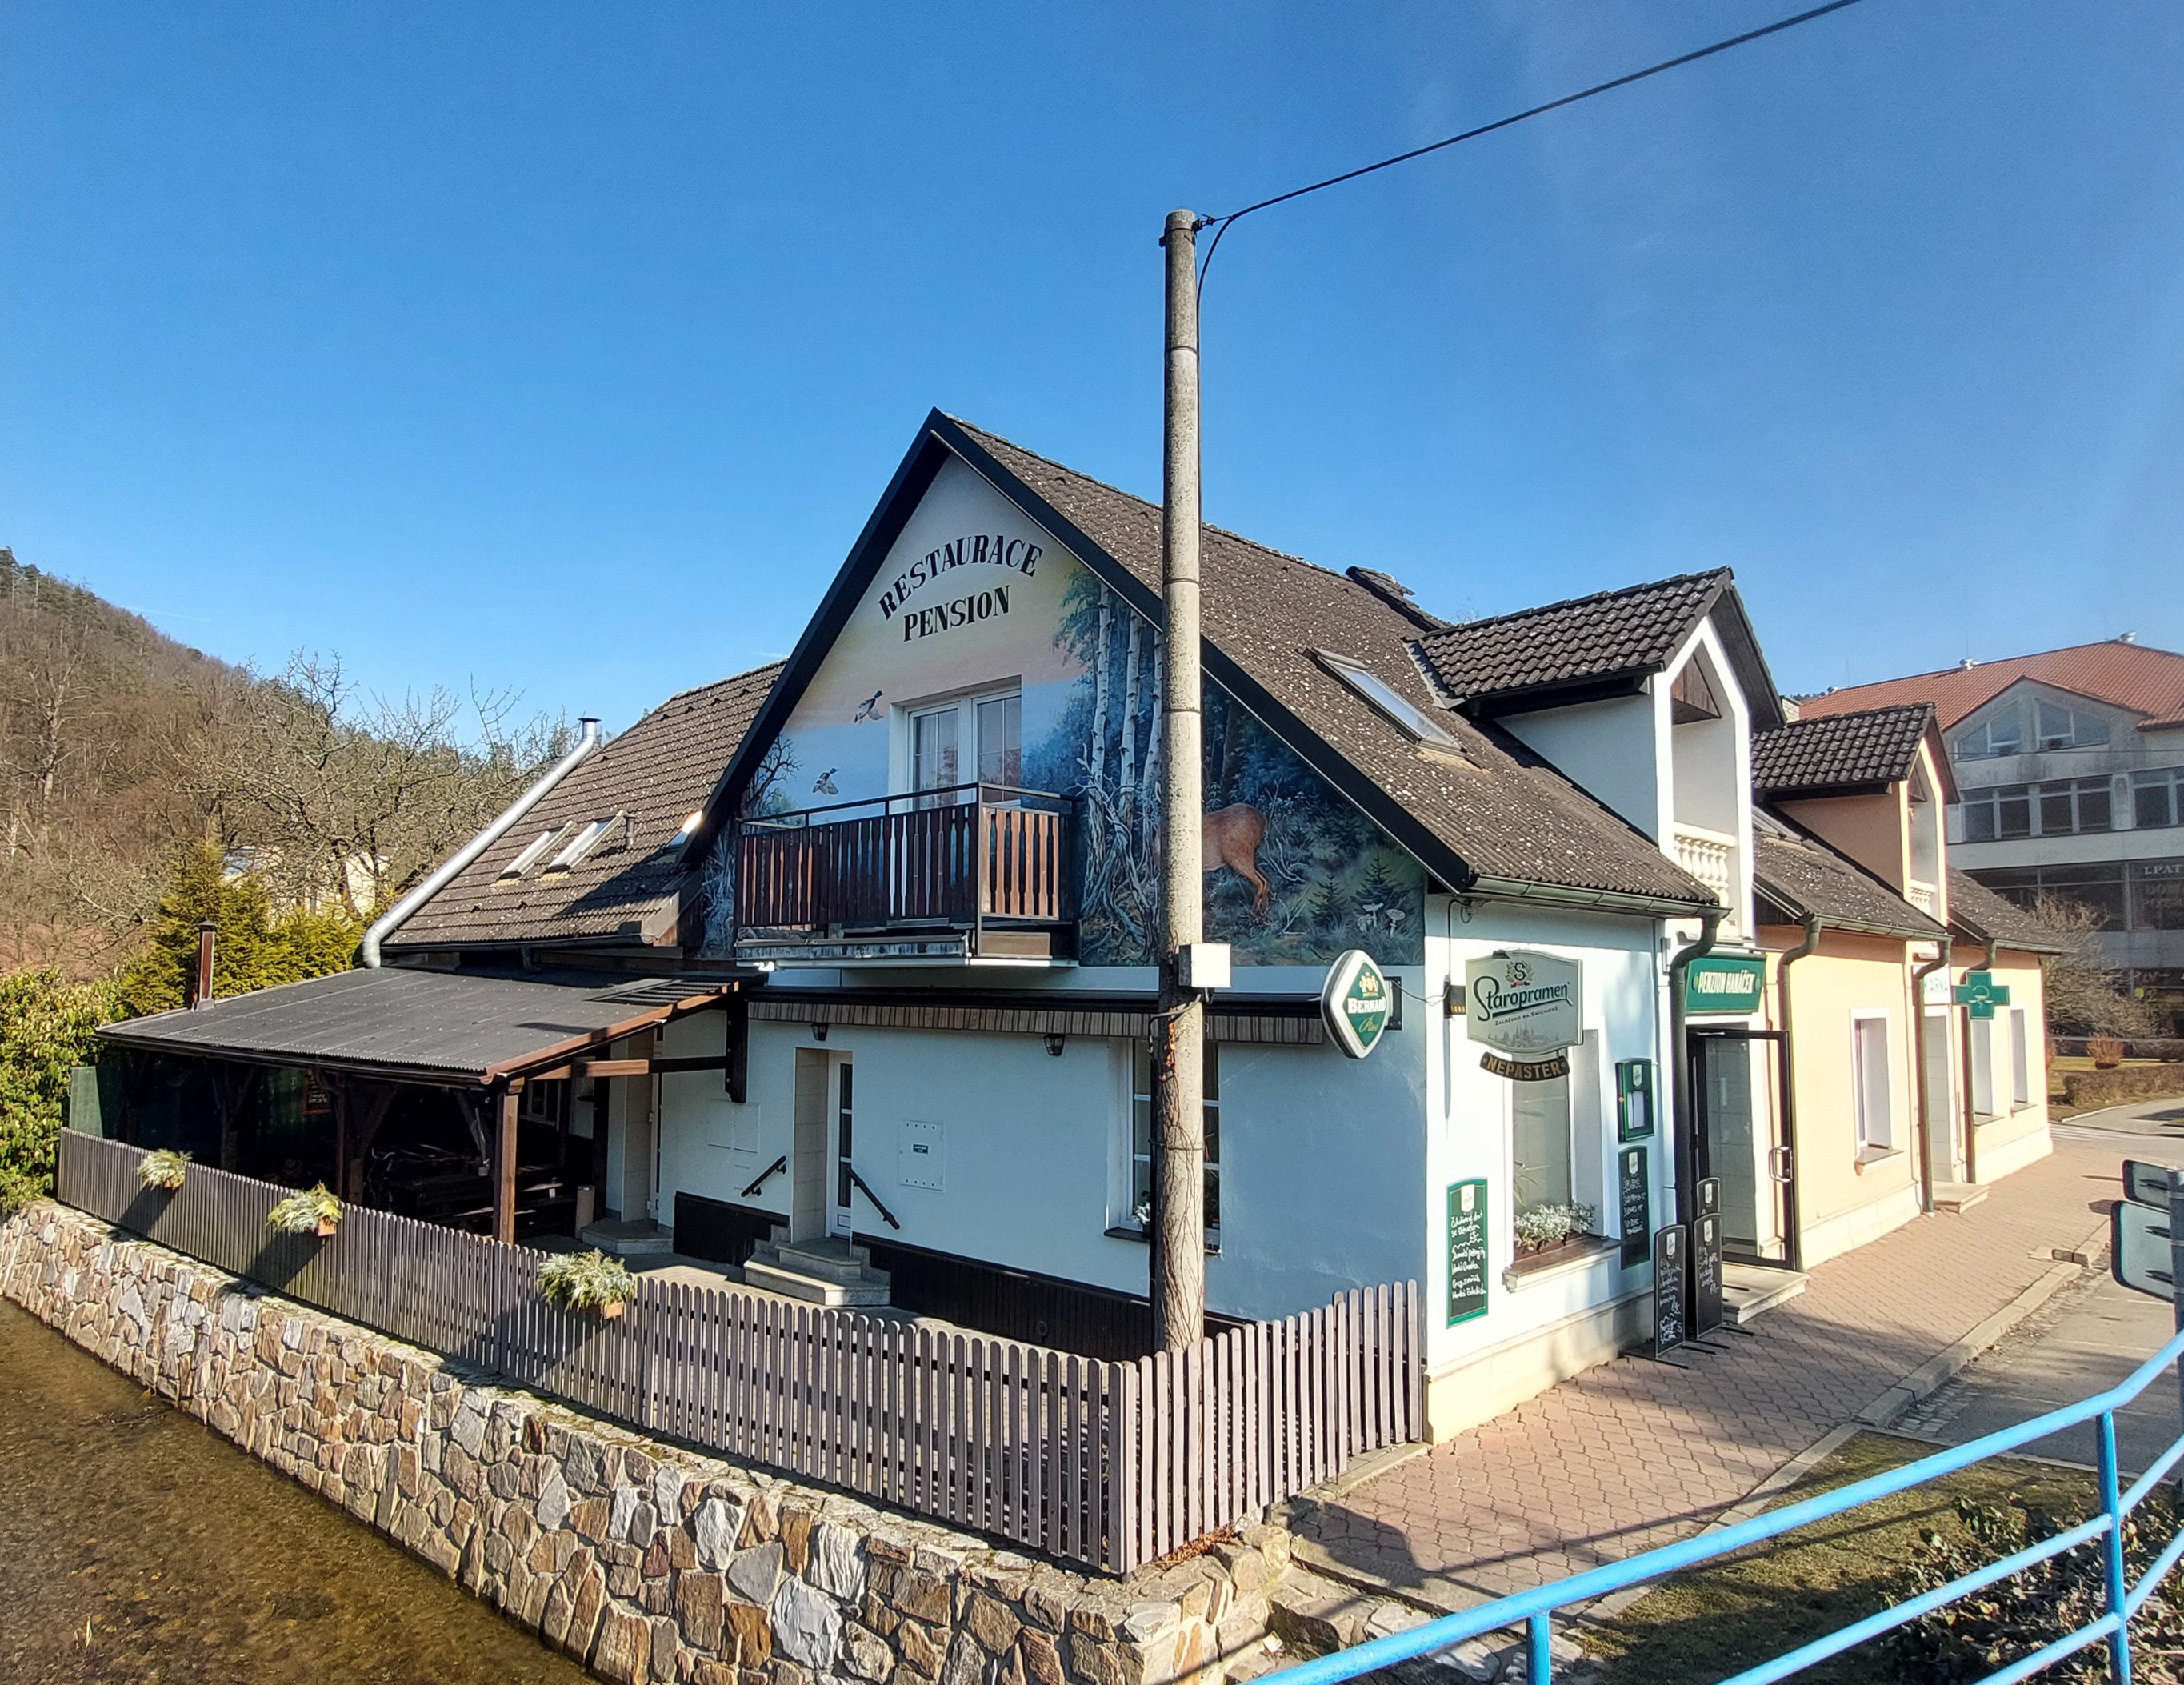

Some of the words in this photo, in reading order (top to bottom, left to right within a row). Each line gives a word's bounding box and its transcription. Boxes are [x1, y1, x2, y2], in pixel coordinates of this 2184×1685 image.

[878, 534, 1043, 621] RESTAURACE
[903, 585, 1010, 642] PENSION
[1474, 975, 1570, 1022] Staropramen
[1486, 1056, 1562, 1079] NEPASTER
